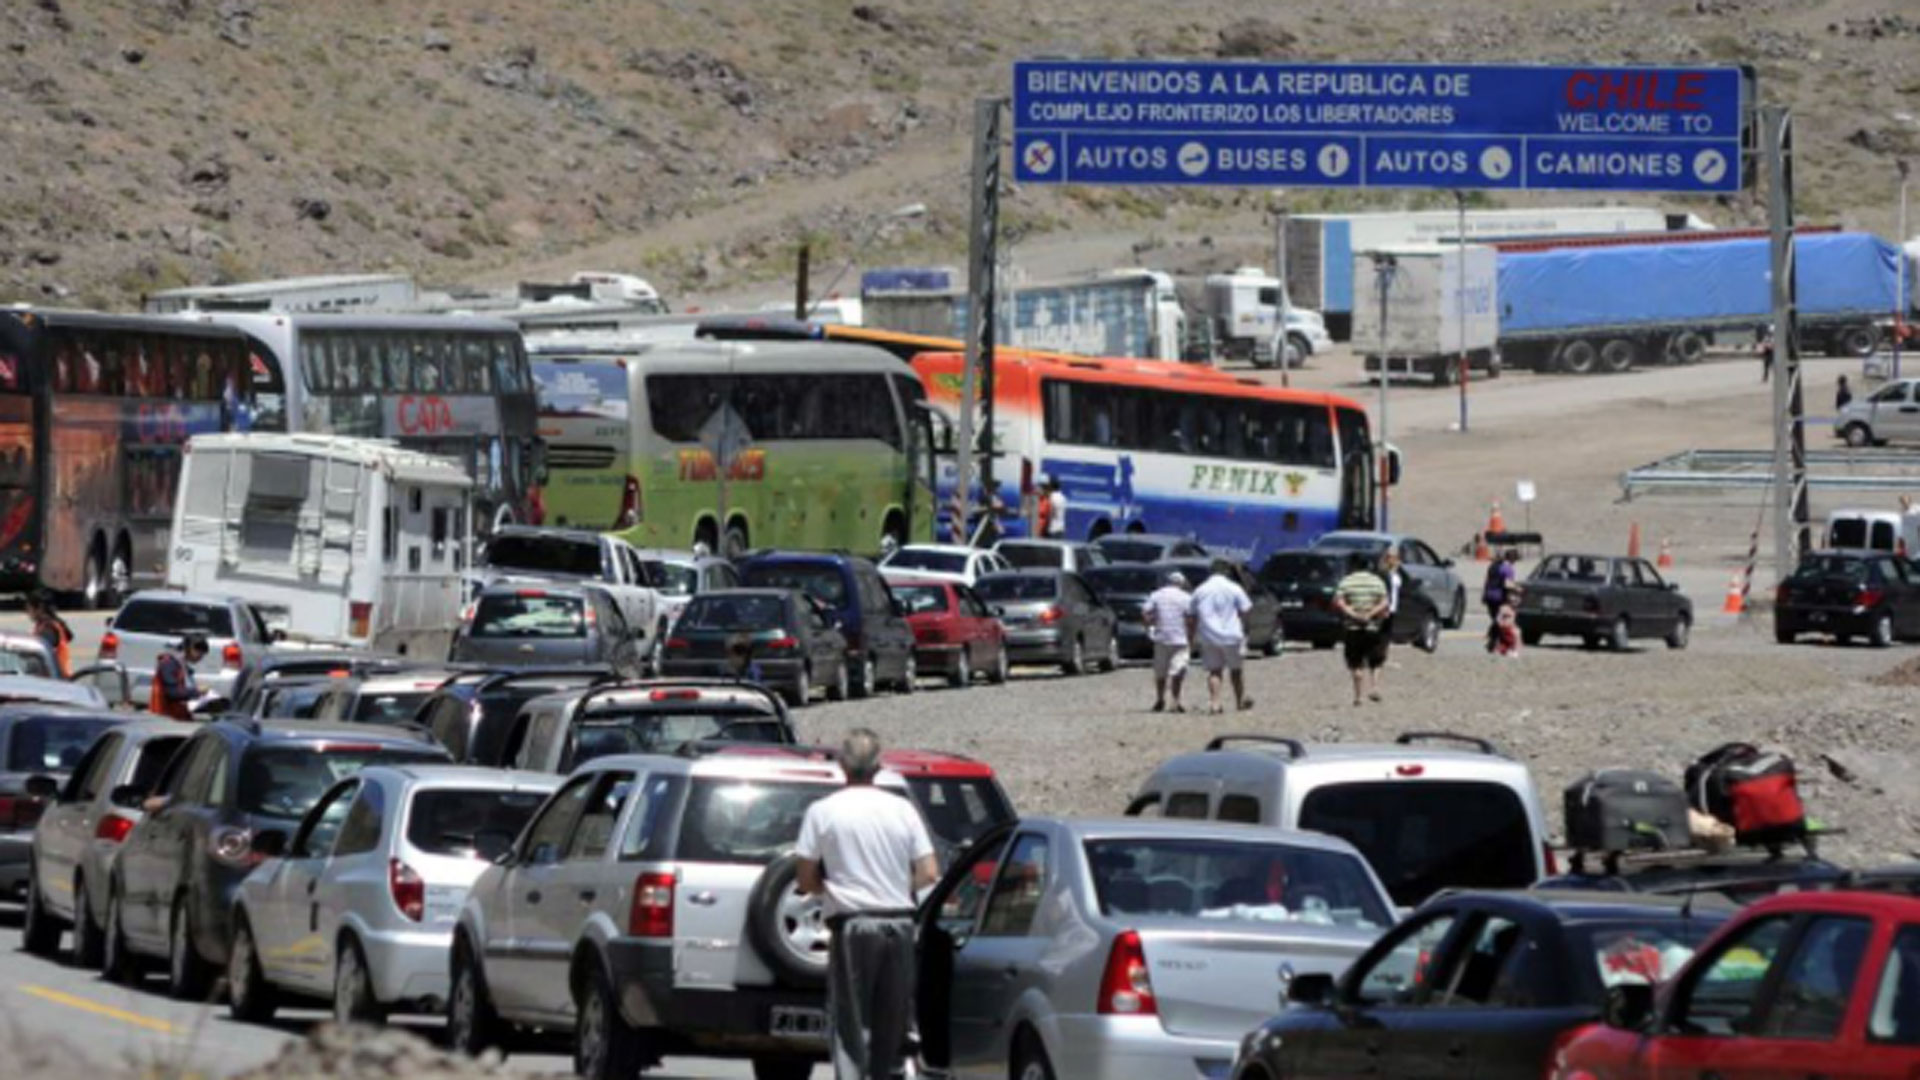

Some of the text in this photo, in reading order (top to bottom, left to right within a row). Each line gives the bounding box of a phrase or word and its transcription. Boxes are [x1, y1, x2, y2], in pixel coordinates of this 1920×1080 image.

[1028, 71, 1470, 97] BIENVENIDOS A LA REPUBLICA DE
[1566, 70, 1708, 110] CHILE
[1029, 102, 1454, 124] COMPLEJO FRONTERIZO LOS LIBERTADORES
[1558, 113, 1712, 133] WELCOME TO
[1076, 147, 1168, 169] AUTOS
[1217, 148, 1307, 171] BUSES
[1375, 150, 1468, 173] AUTOS
[1536, 153, 1683, 176] CAMIONES
[1190, 464, 1279, 495] FENIX
